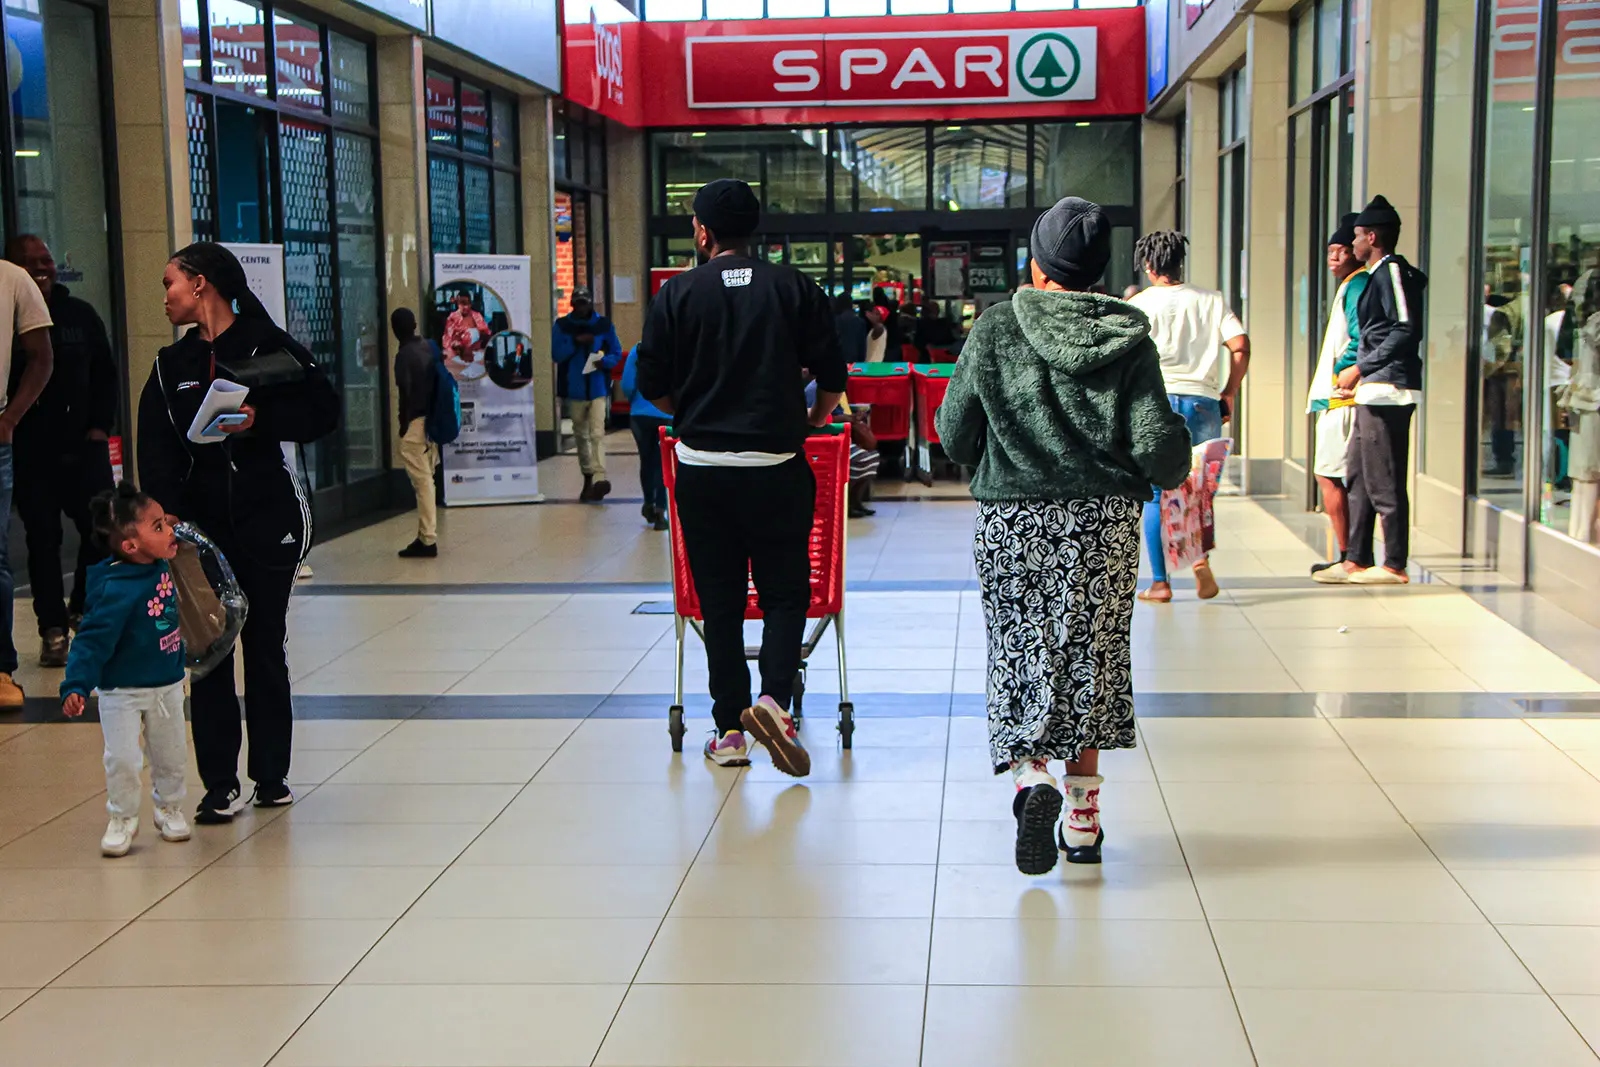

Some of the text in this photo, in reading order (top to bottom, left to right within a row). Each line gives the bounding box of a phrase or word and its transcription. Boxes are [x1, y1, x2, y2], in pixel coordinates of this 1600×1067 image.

[773, 46, 1003, 92] SPAR
[241, 256, 271, 264] CENTRE
[722, 268, 752, 279] BLACK
[969, 268, 1004, 277] FREE
[724, 277, 751, 286] CHILD
[969, 278, 1005, 286] DATA
